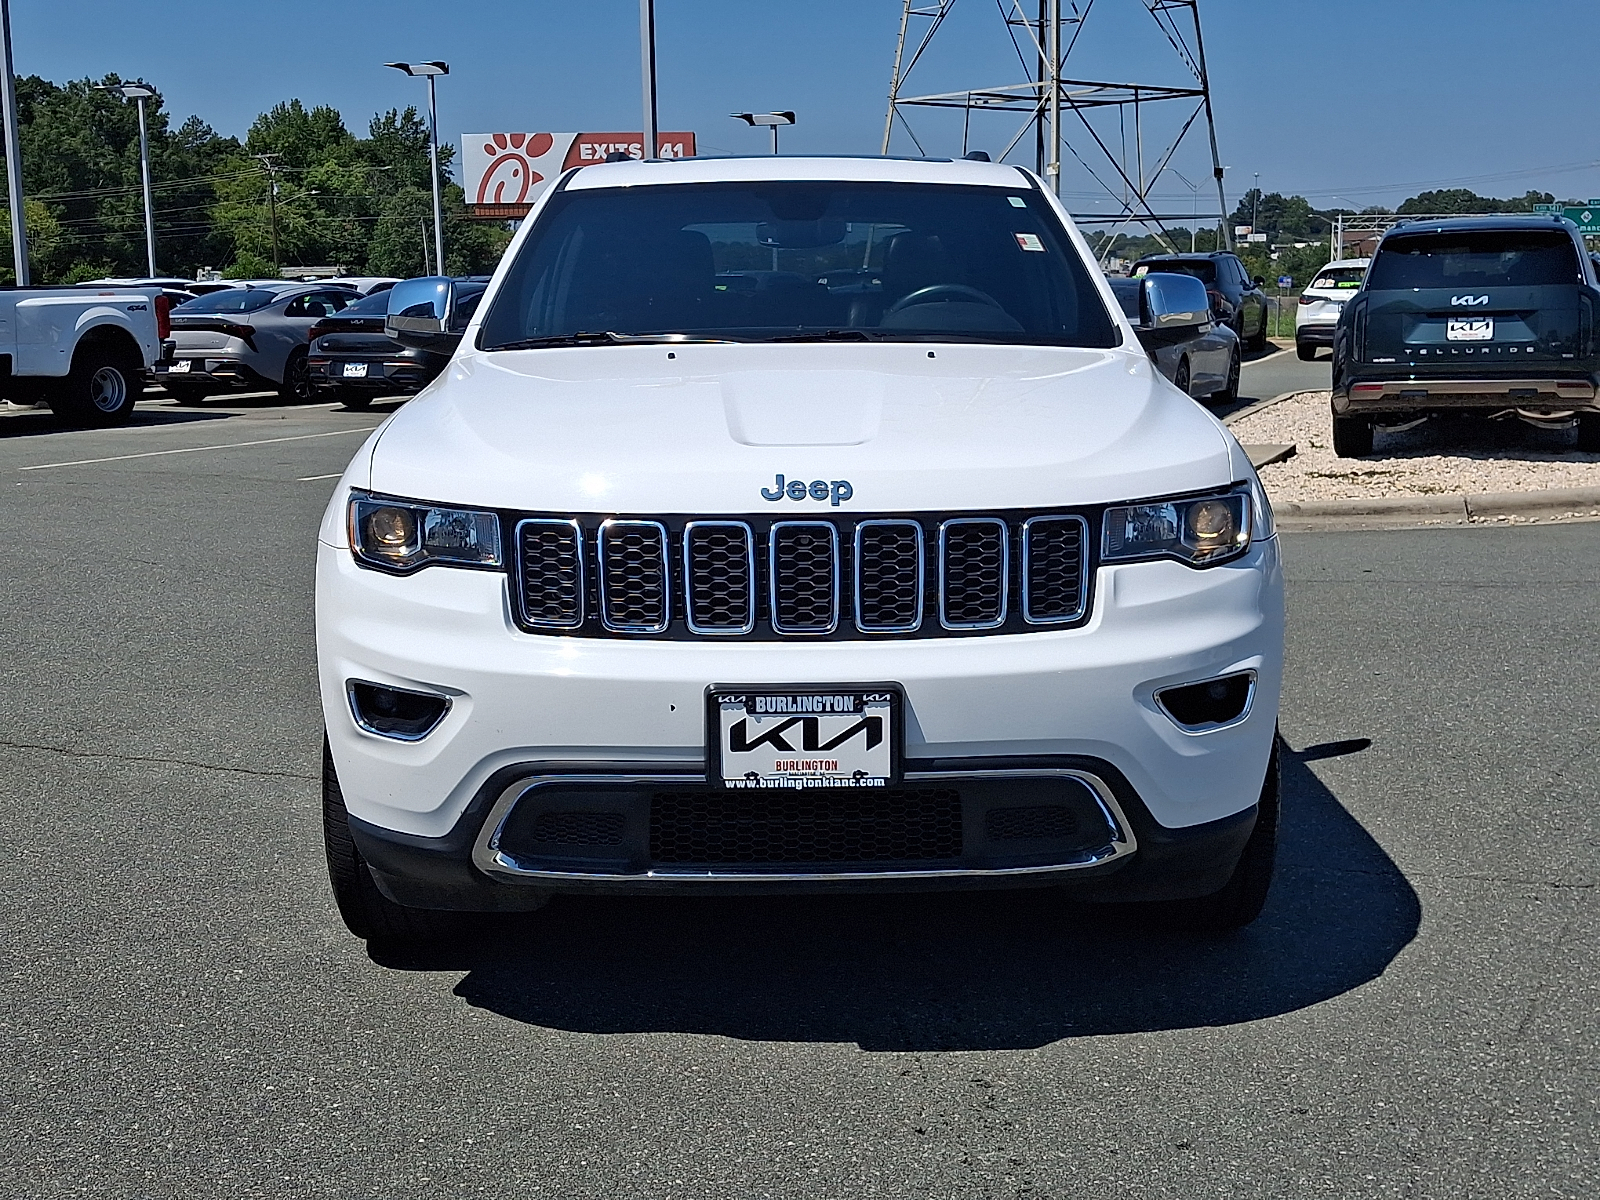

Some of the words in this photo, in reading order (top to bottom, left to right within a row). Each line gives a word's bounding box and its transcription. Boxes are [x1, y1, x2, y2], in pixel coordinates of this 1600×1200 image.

[580, 143, 643, 160] EXITS
[1451, 295, 1489, 306] KIA
[1451, 321, 1490, 331] KIA
[761, 474, 853, 506] Jeep
[718, 695, 746, 703] KIA
[863, 693, 890, 701] KIA
[755, 696, 854, 712] BURLINGTON
[730, 715, 883, 752] KIA
[775, 760, 838, 771] BURLINGTON
[725, 776, 885, 789] www.burlingtonkianc.com
